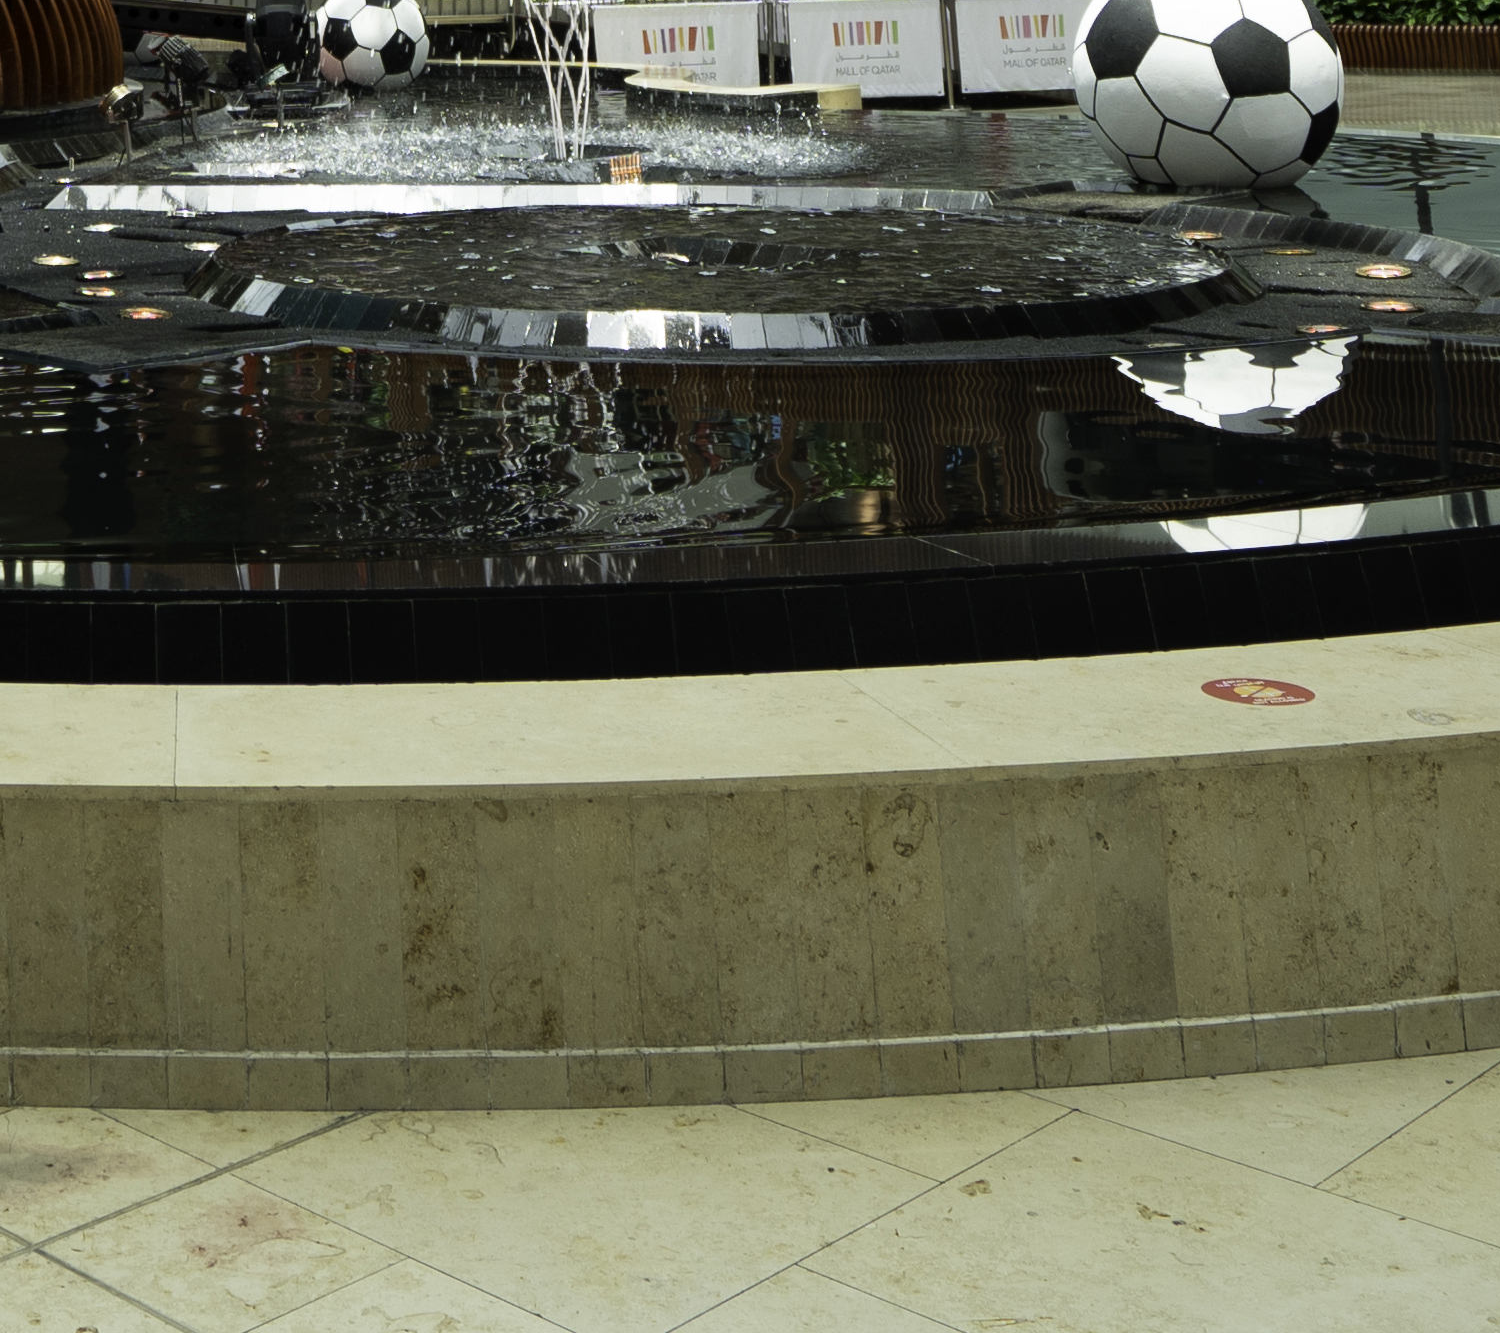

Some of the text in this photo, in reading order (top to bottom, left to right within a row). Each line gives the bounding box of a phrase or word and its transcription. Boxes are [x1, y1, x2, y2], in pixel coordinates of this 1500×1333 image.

[1003, 56, 1068, 69] MALL OF QATAR
[835, 64, 902, 78] MALL OF QATAR
